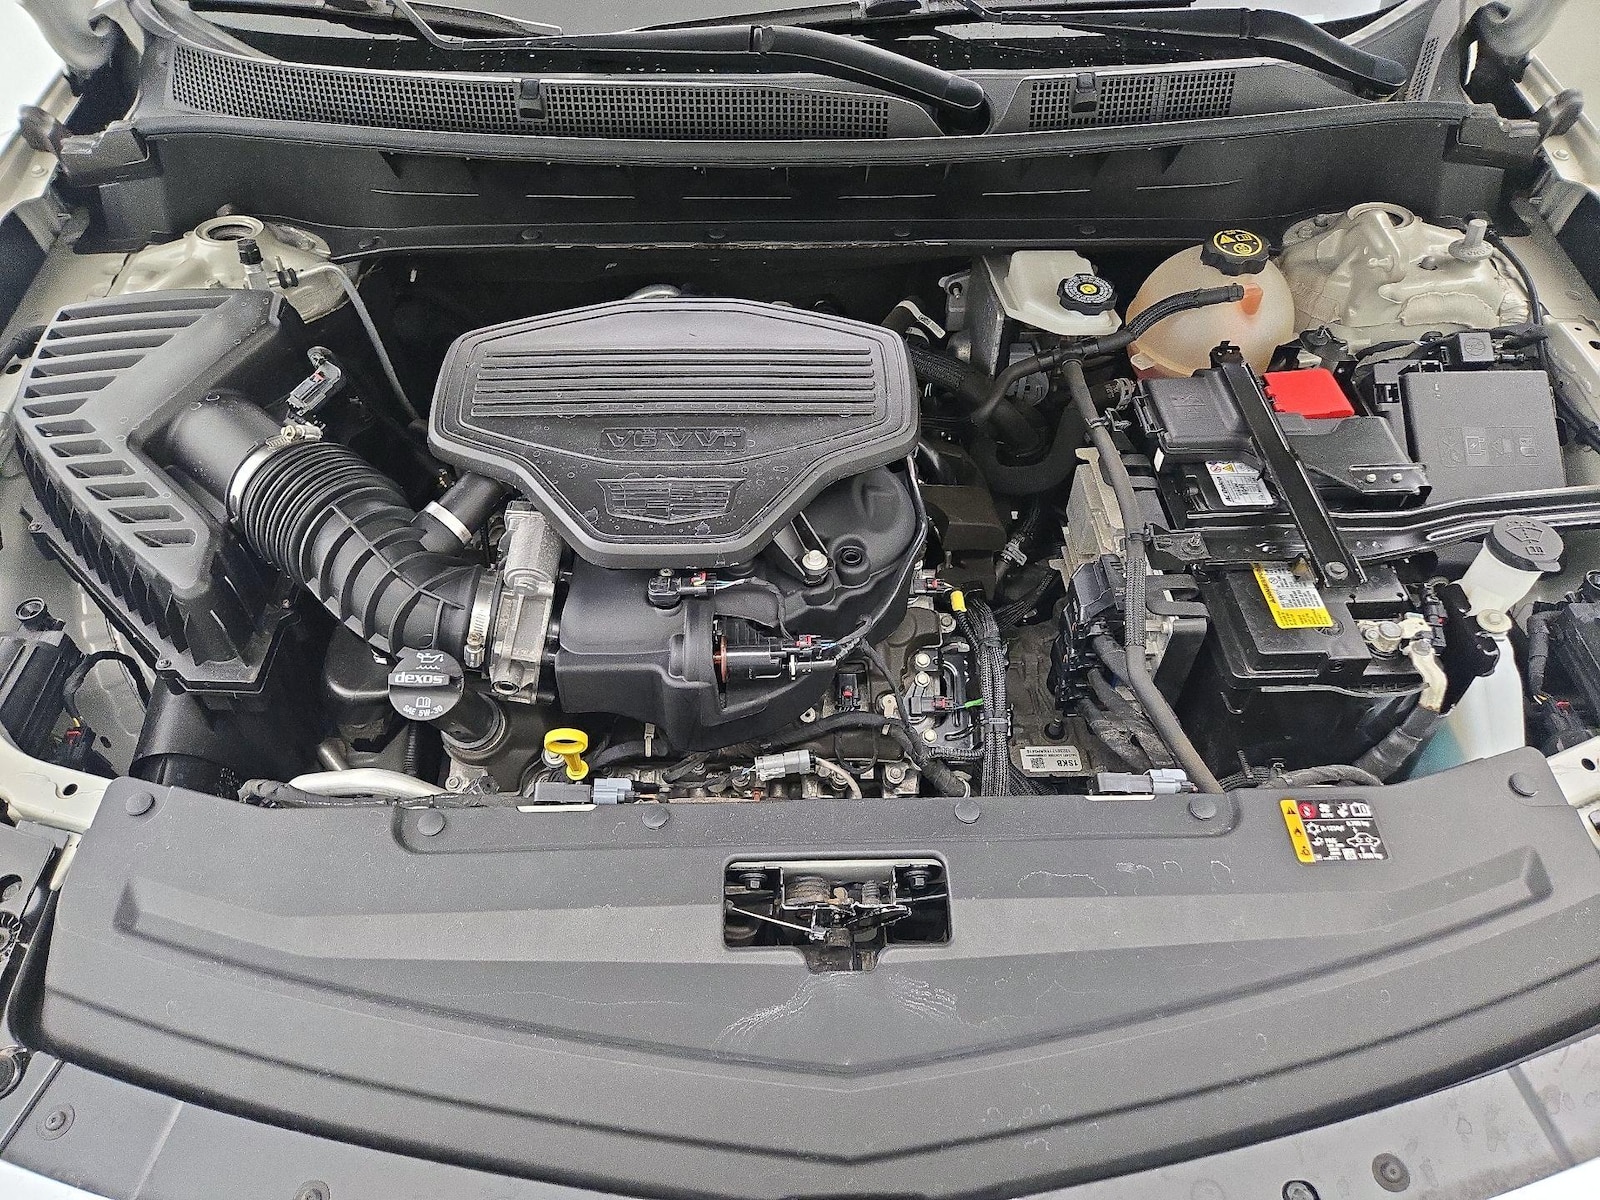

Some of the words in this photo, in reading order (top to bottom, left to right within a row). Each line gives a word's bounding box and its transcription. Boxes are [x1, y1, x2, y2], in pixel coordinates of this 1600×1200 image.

[606, 430, 657, 447] V6
[663, 430, 742, 447] VVT
[394, 671, 445, 684] dexos
[402, 704, 417, 716] SAE
[418, 704, 444, 717] 5W-30
[1056, 759, 1079, 767] 1SKB
